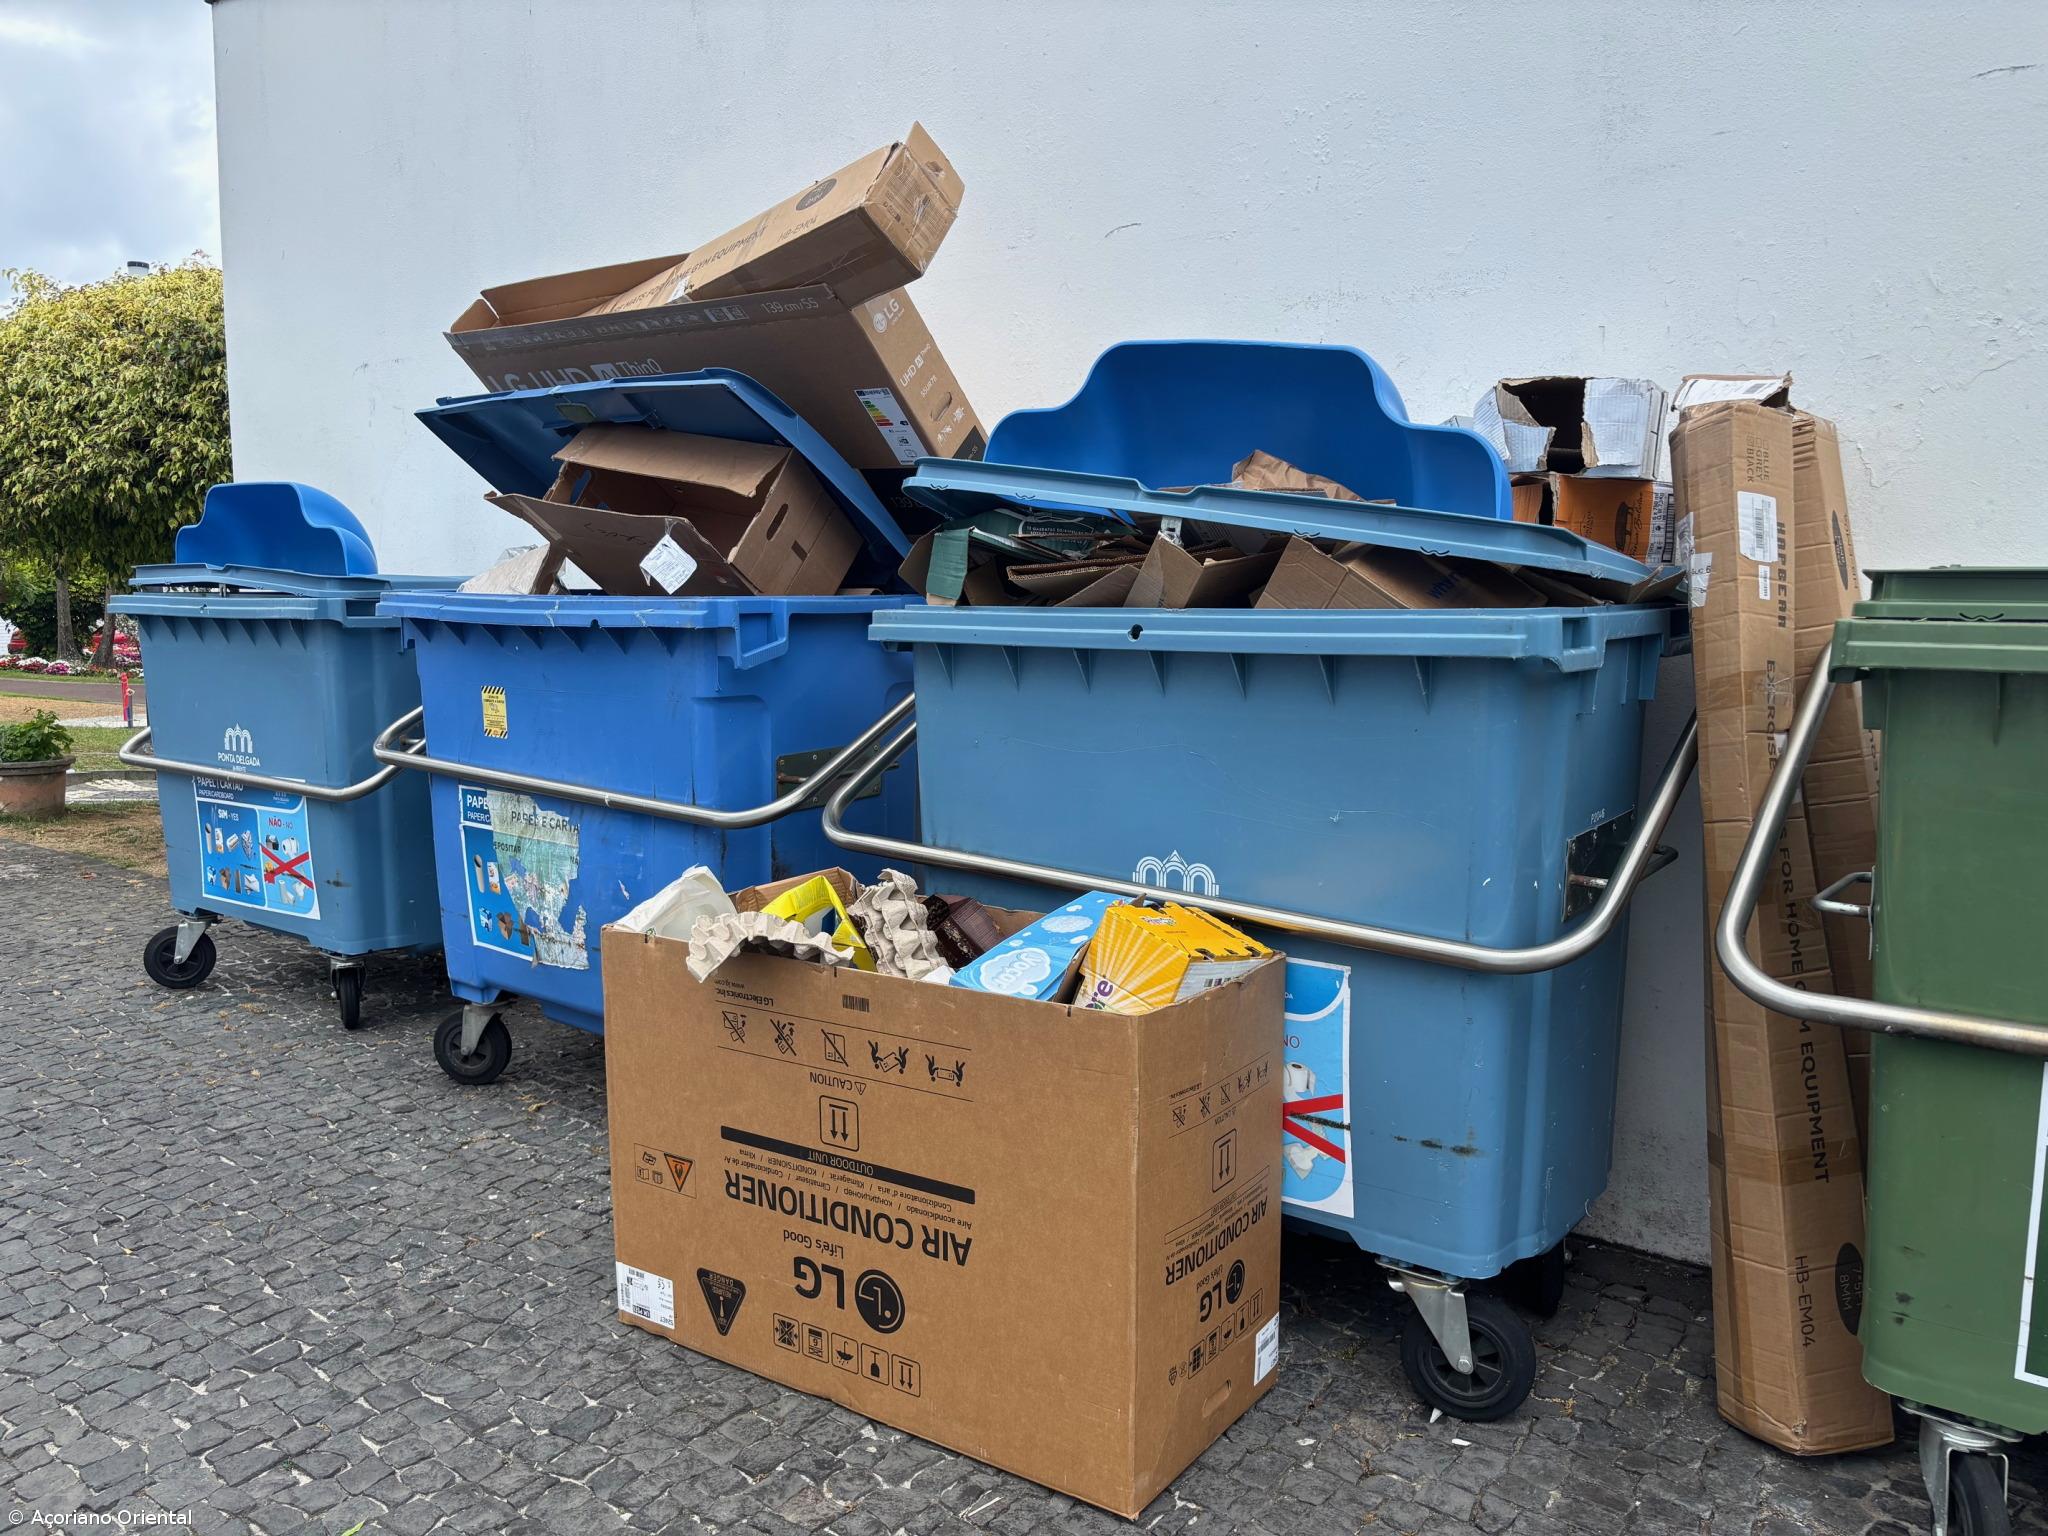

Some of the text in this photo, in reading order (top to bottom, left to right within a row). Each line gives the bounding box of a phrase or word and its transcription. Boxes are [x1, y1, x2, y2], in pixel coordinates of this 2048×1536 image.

[884, 298, 900, 320] LG
[615, 358, 664, 376] ThinQ
[900, 364, 917, 388] UHD
[1755, 449, 1763, 481] GREY
[218, 752, 261, 767] PONTA DELGADA
[197, 776, 216, 788] PAPEL
[218, 809, 228, 820] SIM
[268, 815, 282, 829] NÃO
[1780, 848, 1794, 894] FOR
[1785, 902, 1804, 974] HOME
[727, 990, 763, 1006] Electronics
[763, 995, 774, 1007] LG
[809, 1071, 853, 1091] CAUTION
[1801, 1041, 1829, 1183] EQUIPMENT
[723, 1155, 731, 1165] Ar
[731, 1157, 740, 1168] de
[739, 1148, 756, 1160] Klima
[808, 1150, 874, 1176] OUTDOOR UNIT
[740, 1159, 783, 1179] Condicionador
[768, 1156, 817, 1176] KONDITSIONER
[795, 1175, 831, 1192] Climatiseur
[830, 1172, 865, 1190] Klimagerät
[878, 1185, 890, 1196] aria
[843, 1188, 893, 1208] кондиционер
[898, 1191, 952, 1212] Condizionatore
[723, 1169, 973, 1267] AIR CONDITIONER
[906, 1205, 956, 1225] acondicionado
[1252, 1195, 1267, 1225] AIR
[957, 1219, 972, 1230] Aire
[783, 1229, 844, 1259] Life's Good
[1166, 1212, 1249, 1286] CONDITIONER
[709, 1273, 734, 1286] DANGER
[793, 1256, 845, 1310] LG
[1196, 1274, 1210, 1293] Good
[1199, 1280, 1222, 1323] LG
[1795, 1255, 1815, 1348] HB-EM04
[1840, 1274, 1852, 1310] 8MM
